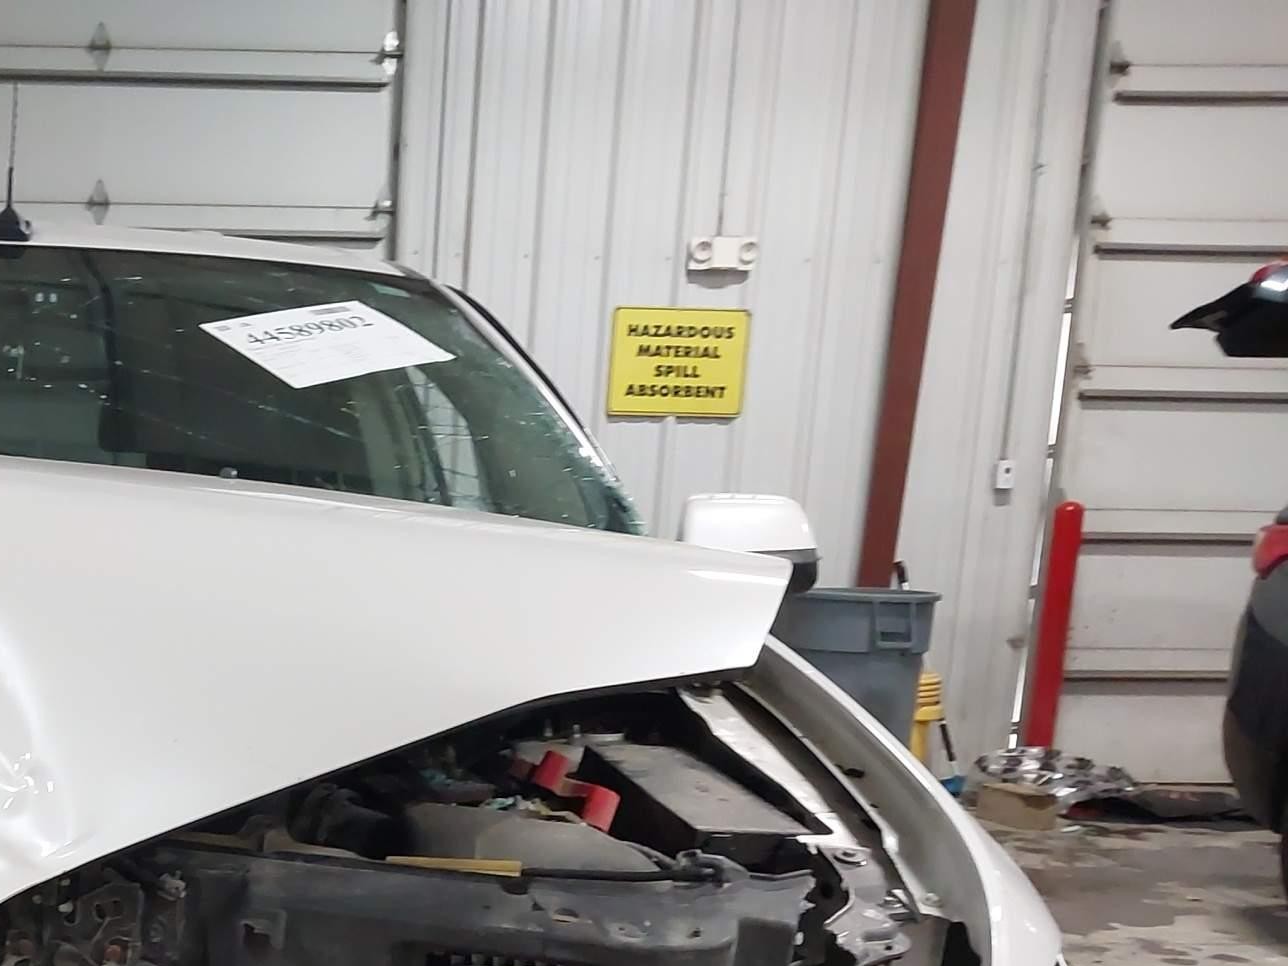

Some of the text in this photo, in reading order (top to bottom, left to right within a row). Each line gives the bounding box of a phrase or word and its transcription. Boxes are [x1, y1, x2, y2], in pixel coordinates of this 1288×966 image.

[247, 315, 374, 344] 44589802
[626, 324, 736, 340] HAZARDOUS
[636, 344, 722, 359] MATERIAL
[653, 364, 701, 379] SPILL
[625, 383, 727, 399] ABSORBENT
